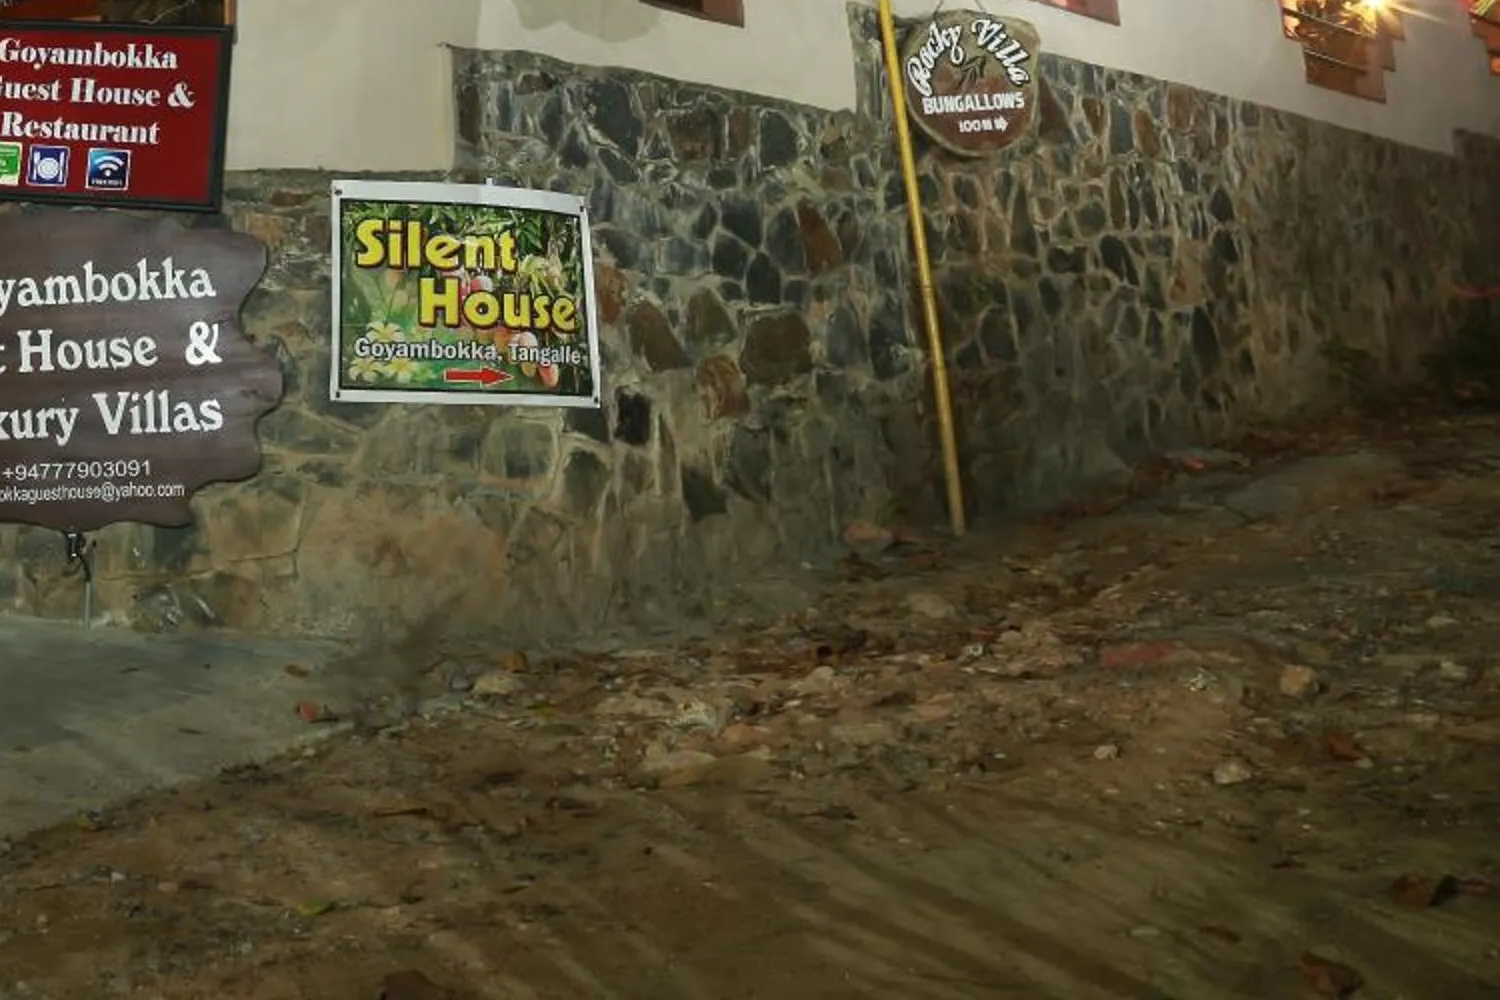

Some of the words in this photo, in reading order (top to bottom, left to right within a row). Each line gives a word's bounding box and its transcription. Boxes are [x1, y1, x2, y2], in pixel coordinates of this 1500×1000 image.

[907, 21, 964, 97] Rocky
[971, 18, 1030, 86] Villa
[70, 77, 161, 106] House
[167, 82, 195, 108] &
[922, 92, 1025, 115] BUNGALLOWS
[0, 111, 161, 145] Restaurant
[356, 218, 519, 272] Silent
[419, 277, 580, 332] House
[17, 329, 158, 373] House
[185, 321, 223, 366] &
[509, 343, 581, 367] Tangalle
[93, 390, 224, 435] Villas
[2, 460, 151, 481] +94777903091
